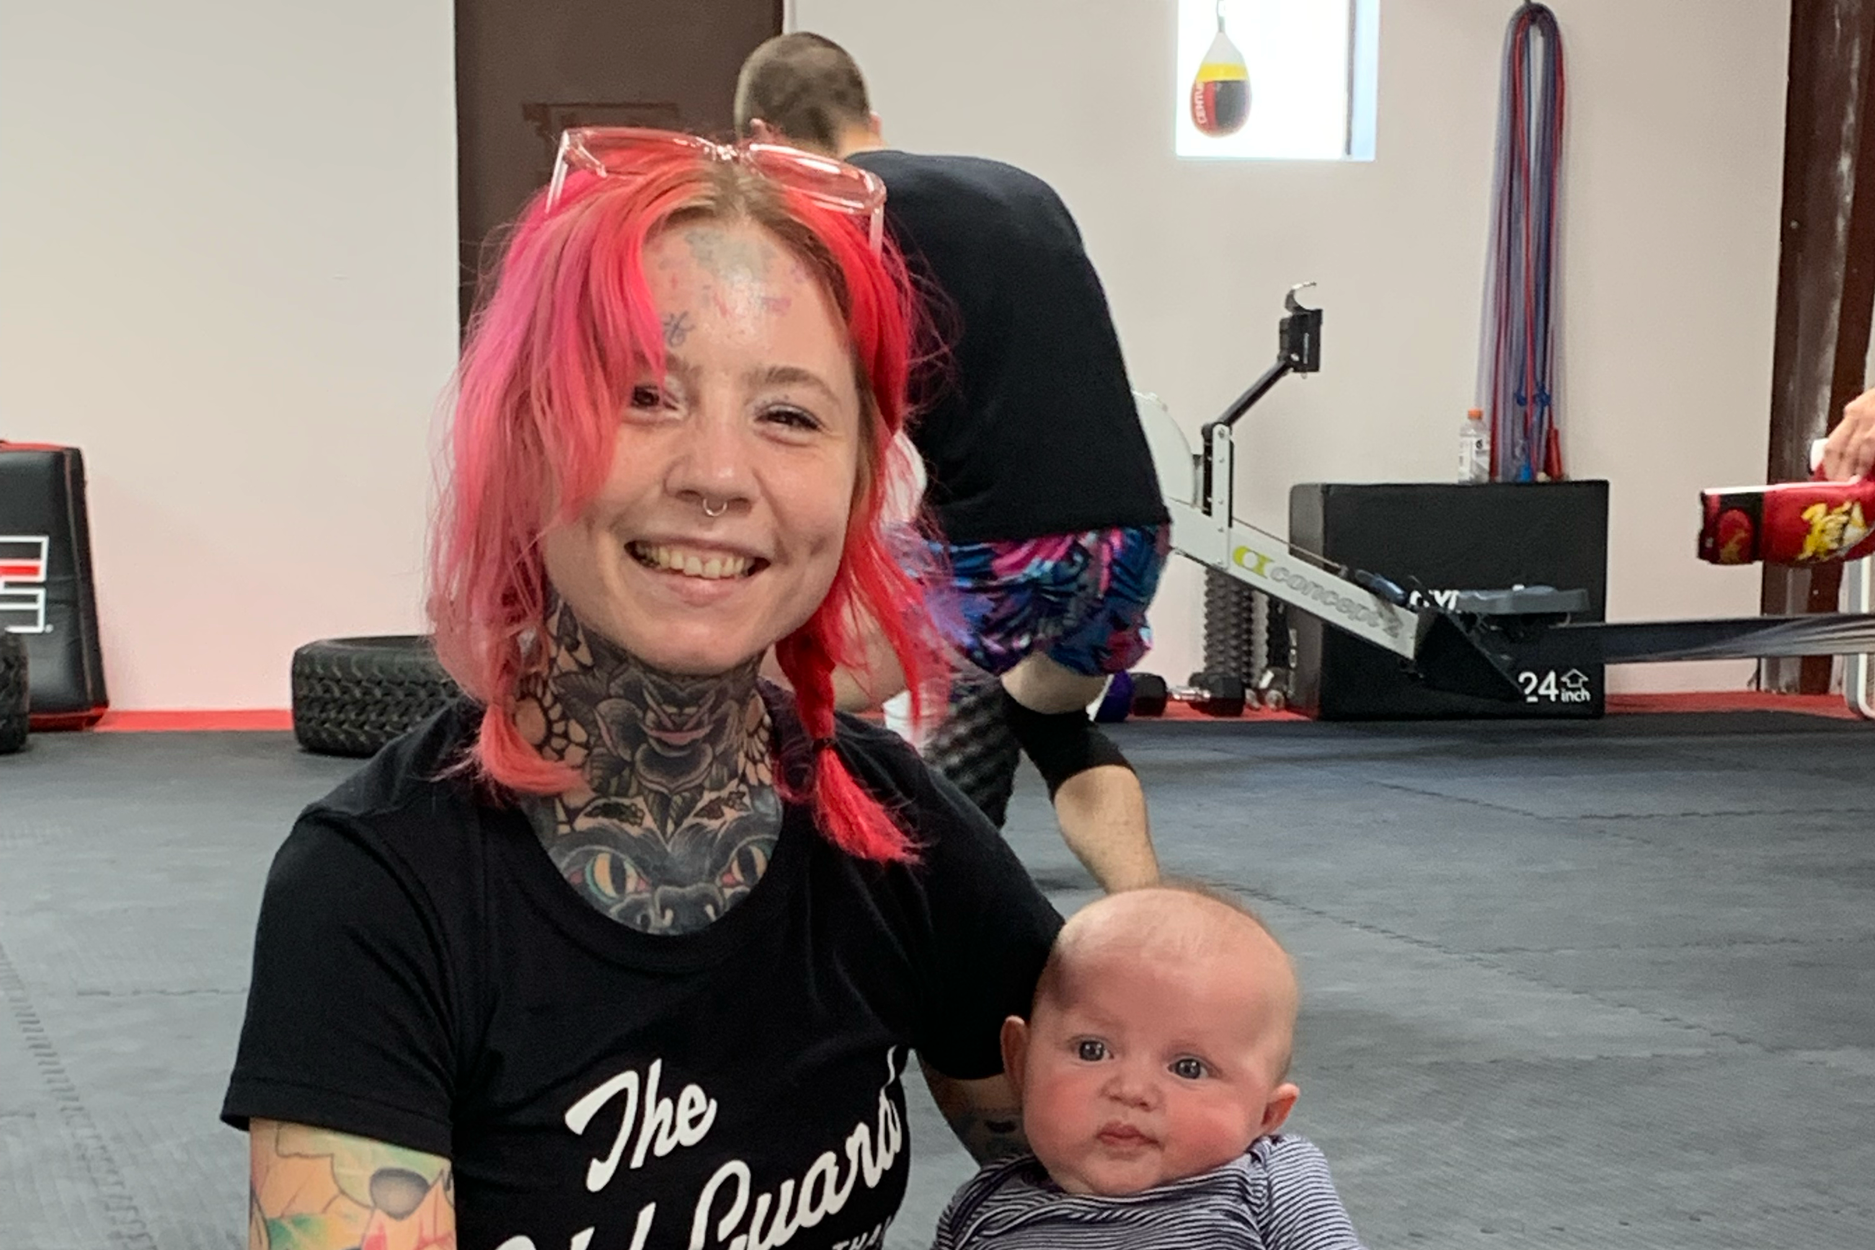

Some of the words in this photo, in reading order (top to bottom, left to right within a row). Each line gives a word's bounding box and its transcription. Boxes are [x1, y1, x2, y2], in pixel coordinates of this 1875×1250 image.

[1518, 669, 1559, 703] 24
[1560, 688, 1591, 703] inch
[565, 1058, 717, 1192] The
